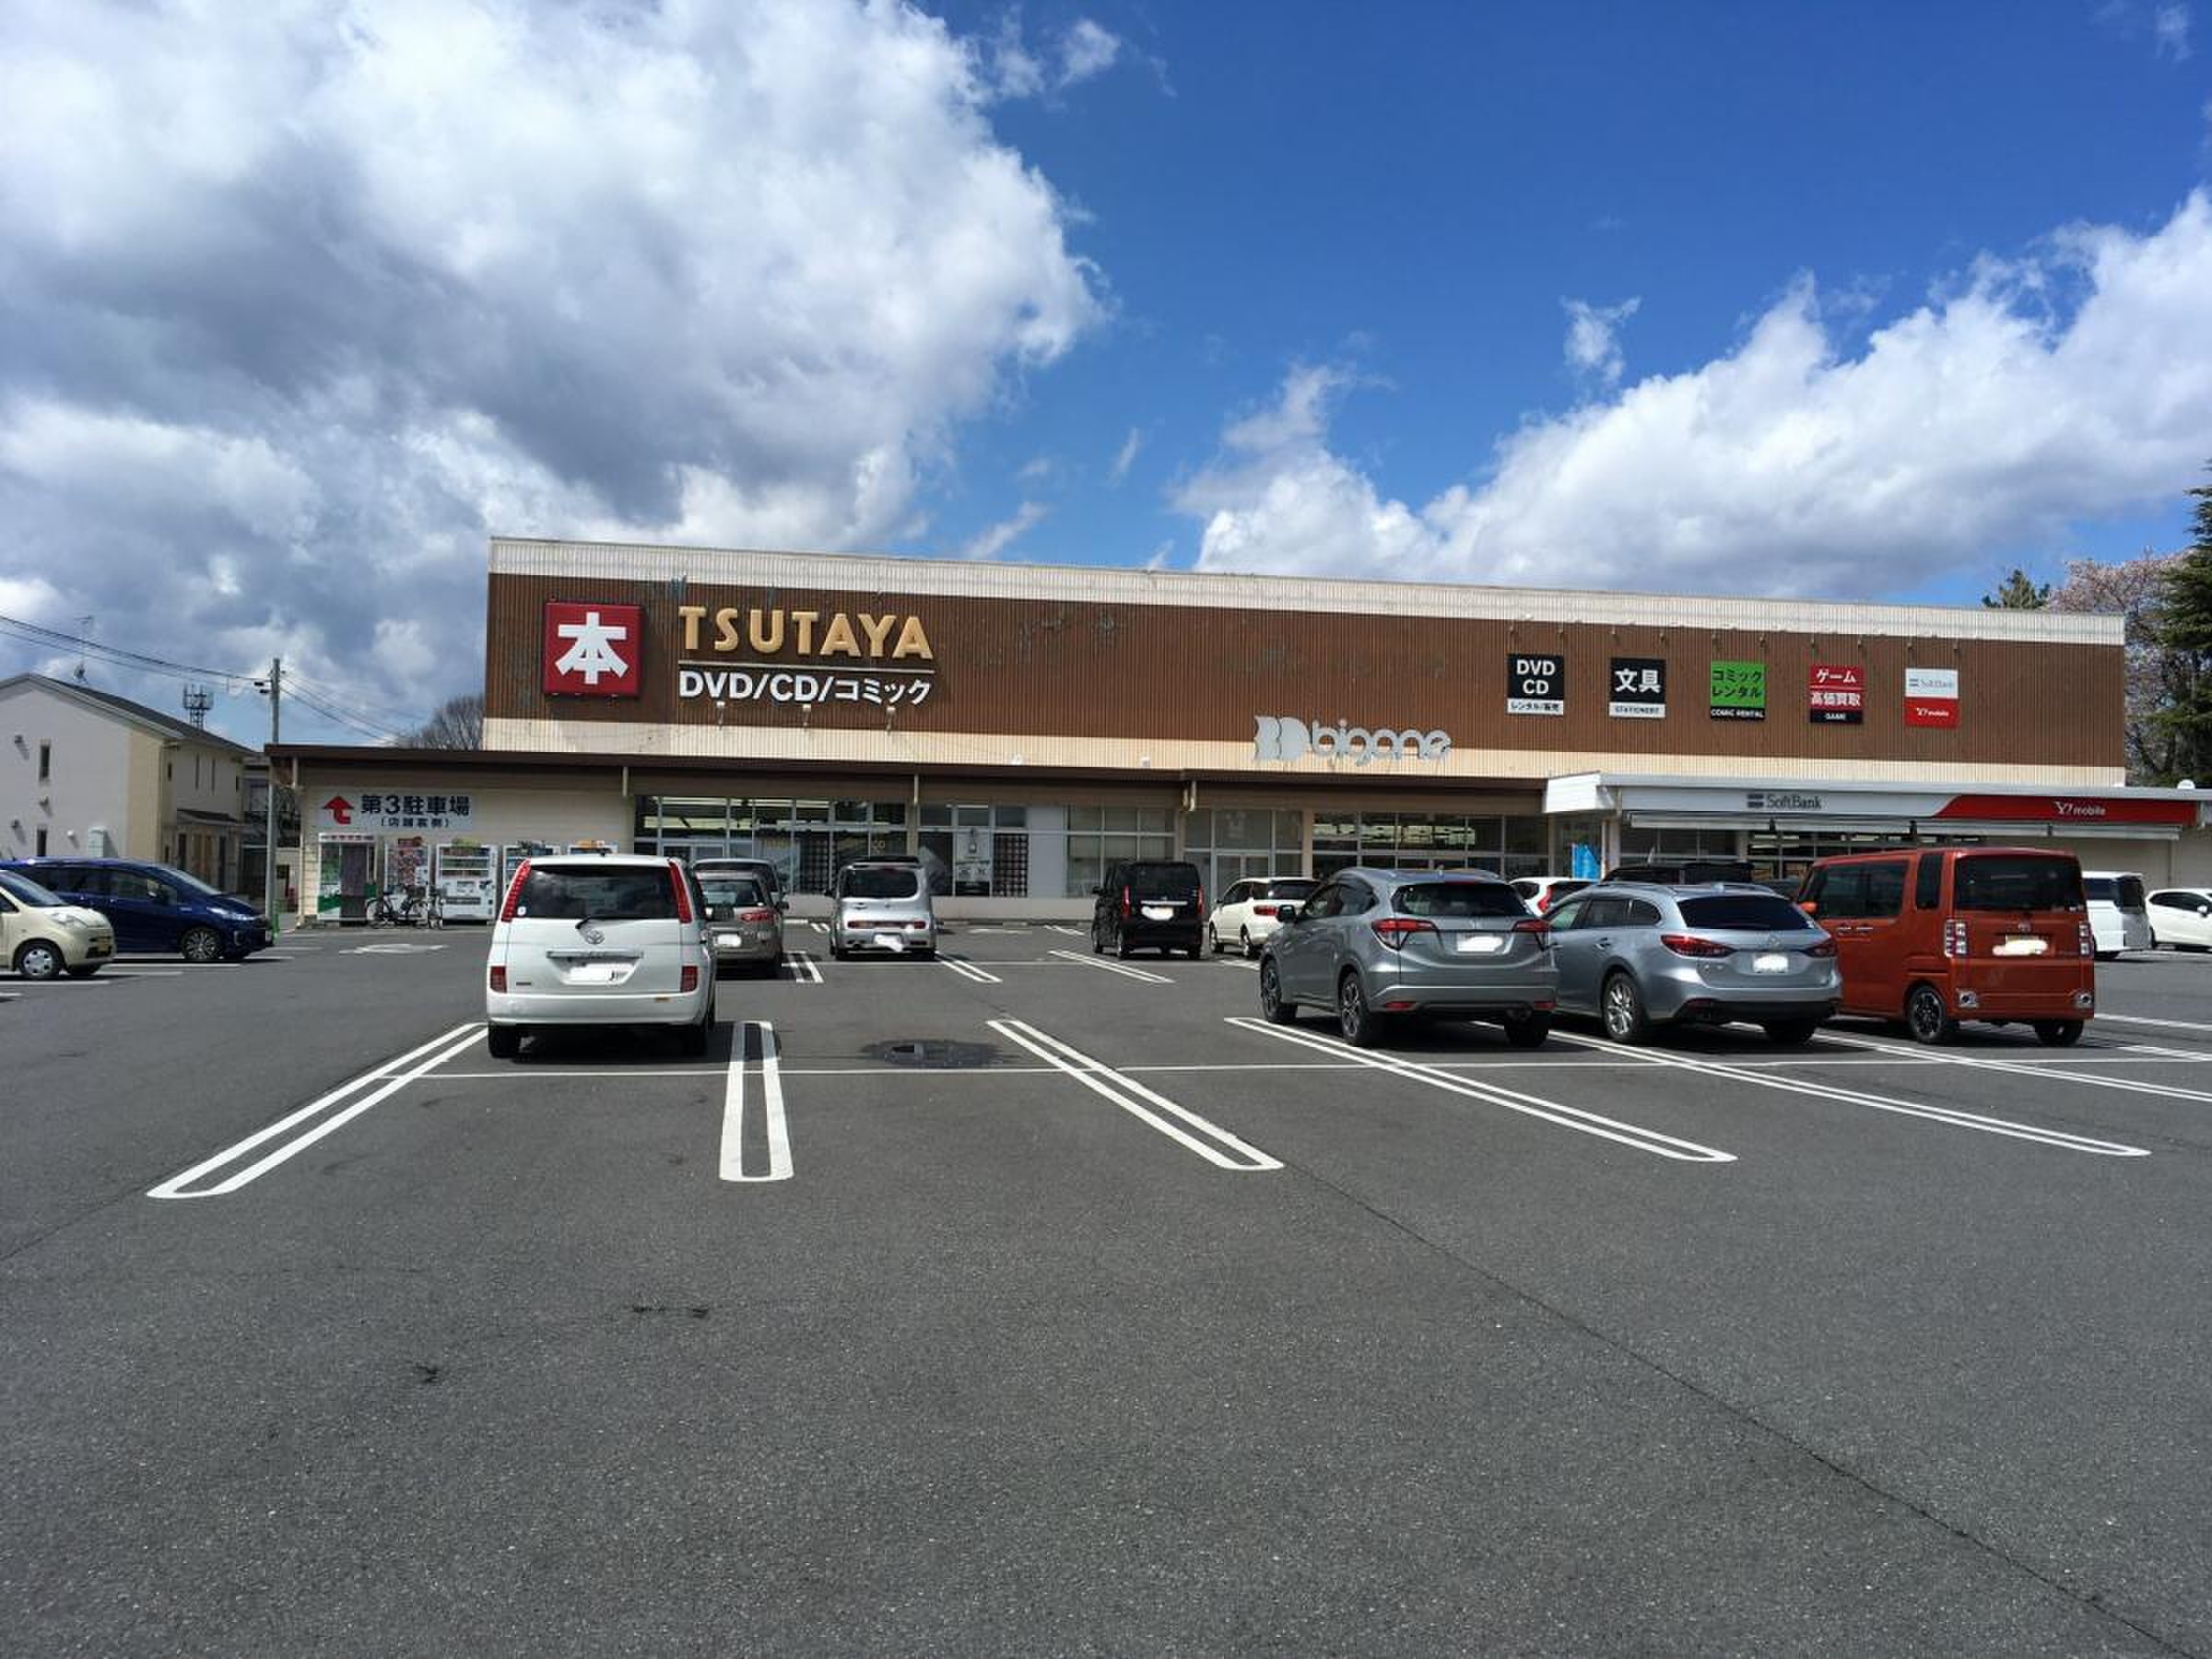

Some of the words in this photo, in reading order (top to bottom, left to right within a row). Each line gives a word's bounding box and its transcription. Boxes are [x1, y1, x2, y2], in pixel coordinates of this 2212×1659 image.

[678, 606, 934, 660] TSUTAYA
[555, 611, 628, 685] 本
[1516, 659, 1556, 676] DVD
[1712, 669, 1762, 683] コミック
[1816, 668, 1857, 683] ゲーム
[679, 670, 932, 705] DVD/CD/コミック
[1523, 679, 1549, 694] CD
[1615, 668, 1661, 693] 文具
[1712, 685, 1762, 698] レンタル
[360, 794, 470, 817] 第3駐車場
[1767, 794, 1822, 810] SoftBank
